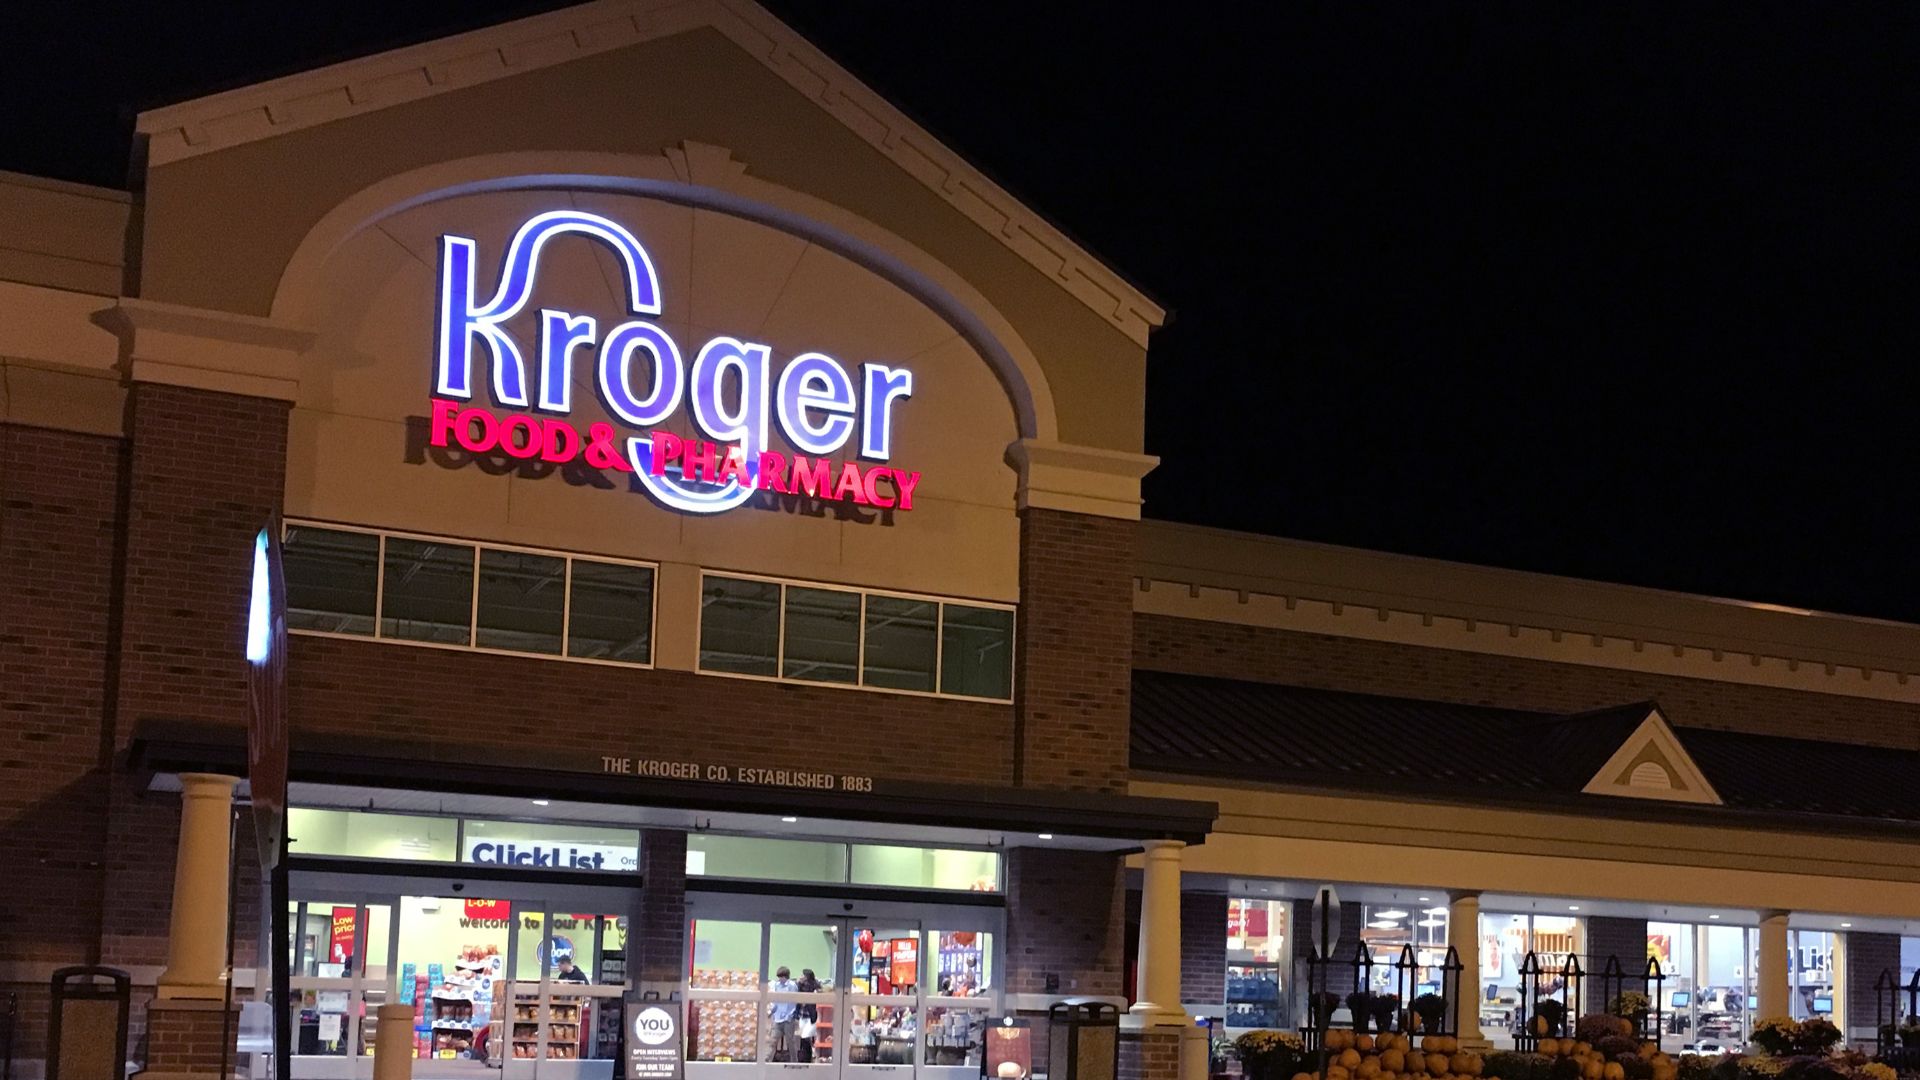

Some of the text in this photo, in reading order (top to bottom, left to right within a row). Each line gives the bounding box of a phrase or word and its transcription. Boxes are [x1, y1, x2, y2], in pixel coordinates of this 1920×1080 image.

[436, 210, 912, 513] Kroger
[430, 398, 921, 511] FOOD & PHARMACY
[602, 756, 873, 793] THE KROGER CO. ESTABLISHED 1883
[472, 842, 604, 871] ClickList
[333, 916, 354, 926] Low
[524, 916, 540, 930] to
[554, 918, 579, 930] our
[640, 1019, 670, 1030] YOU
